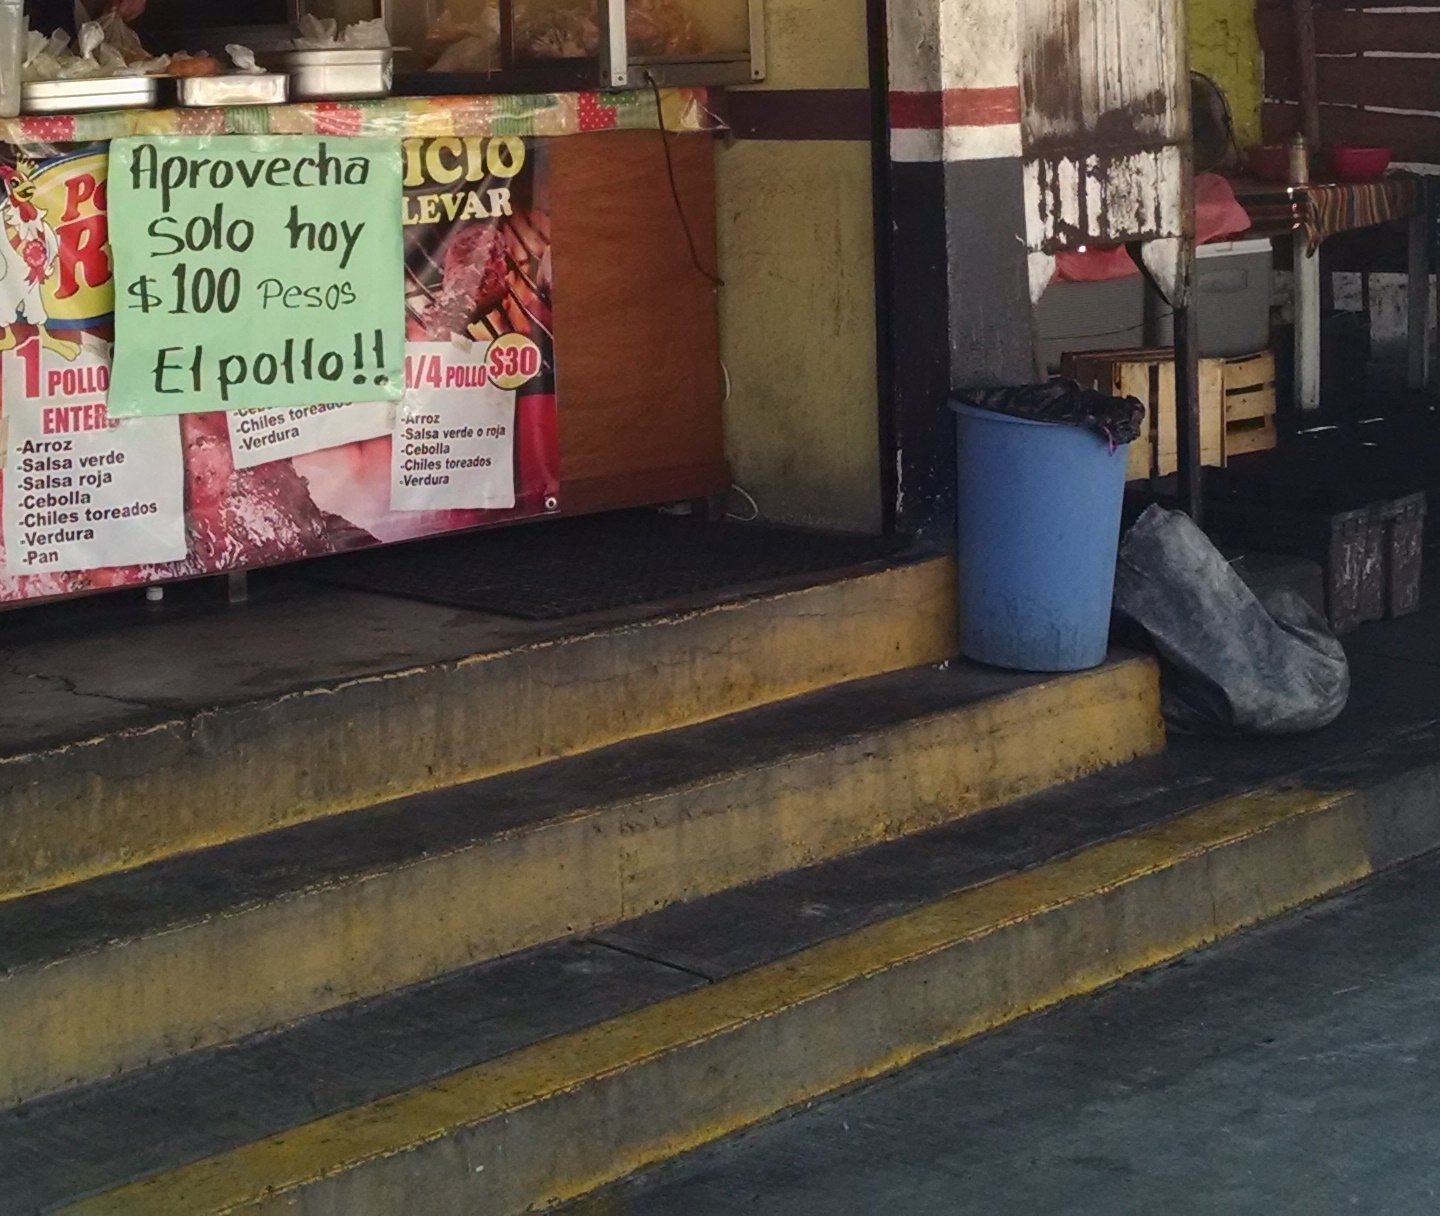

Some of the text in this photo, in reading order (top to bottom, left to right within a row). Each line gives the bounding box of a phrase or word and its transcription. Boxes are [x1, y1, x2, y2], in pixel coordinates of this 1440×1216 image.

[129, 142, 371, 213] Aprovecha
[284, 204, 366, 270] hoy
[127, 262, 241, 315] $100
[16, 338, 109, 399] 1 POLLO
[151, 344, 203, 394] El
[489, 346, 538, 380] $30
[445, 365, 487, 388] POLLO
[235, 412, 286, 435] -Chiles
[401, 428, 439, 441] -Salsa
[443, 426, 474, 439] verde
[486, 424, 506, 439] roja
[16, 439, 73, 455] -Arroz
[238, 426, 300, 452] -Verdura
[401, 442, 450, 456] -Cebolla
[17, 450, 125, 473] -Salsa verde
[400, 455, 492, 471] -Chiles toreados
[17, 470, 113, 491] -Salsa roja
[18, 490, 92, 510] -Cebolla
[18, 501, 158, 528] -Chiles toreados
[20, 528, 95, 547] -Verdura
[22, 550, 59, 566] -Pan
